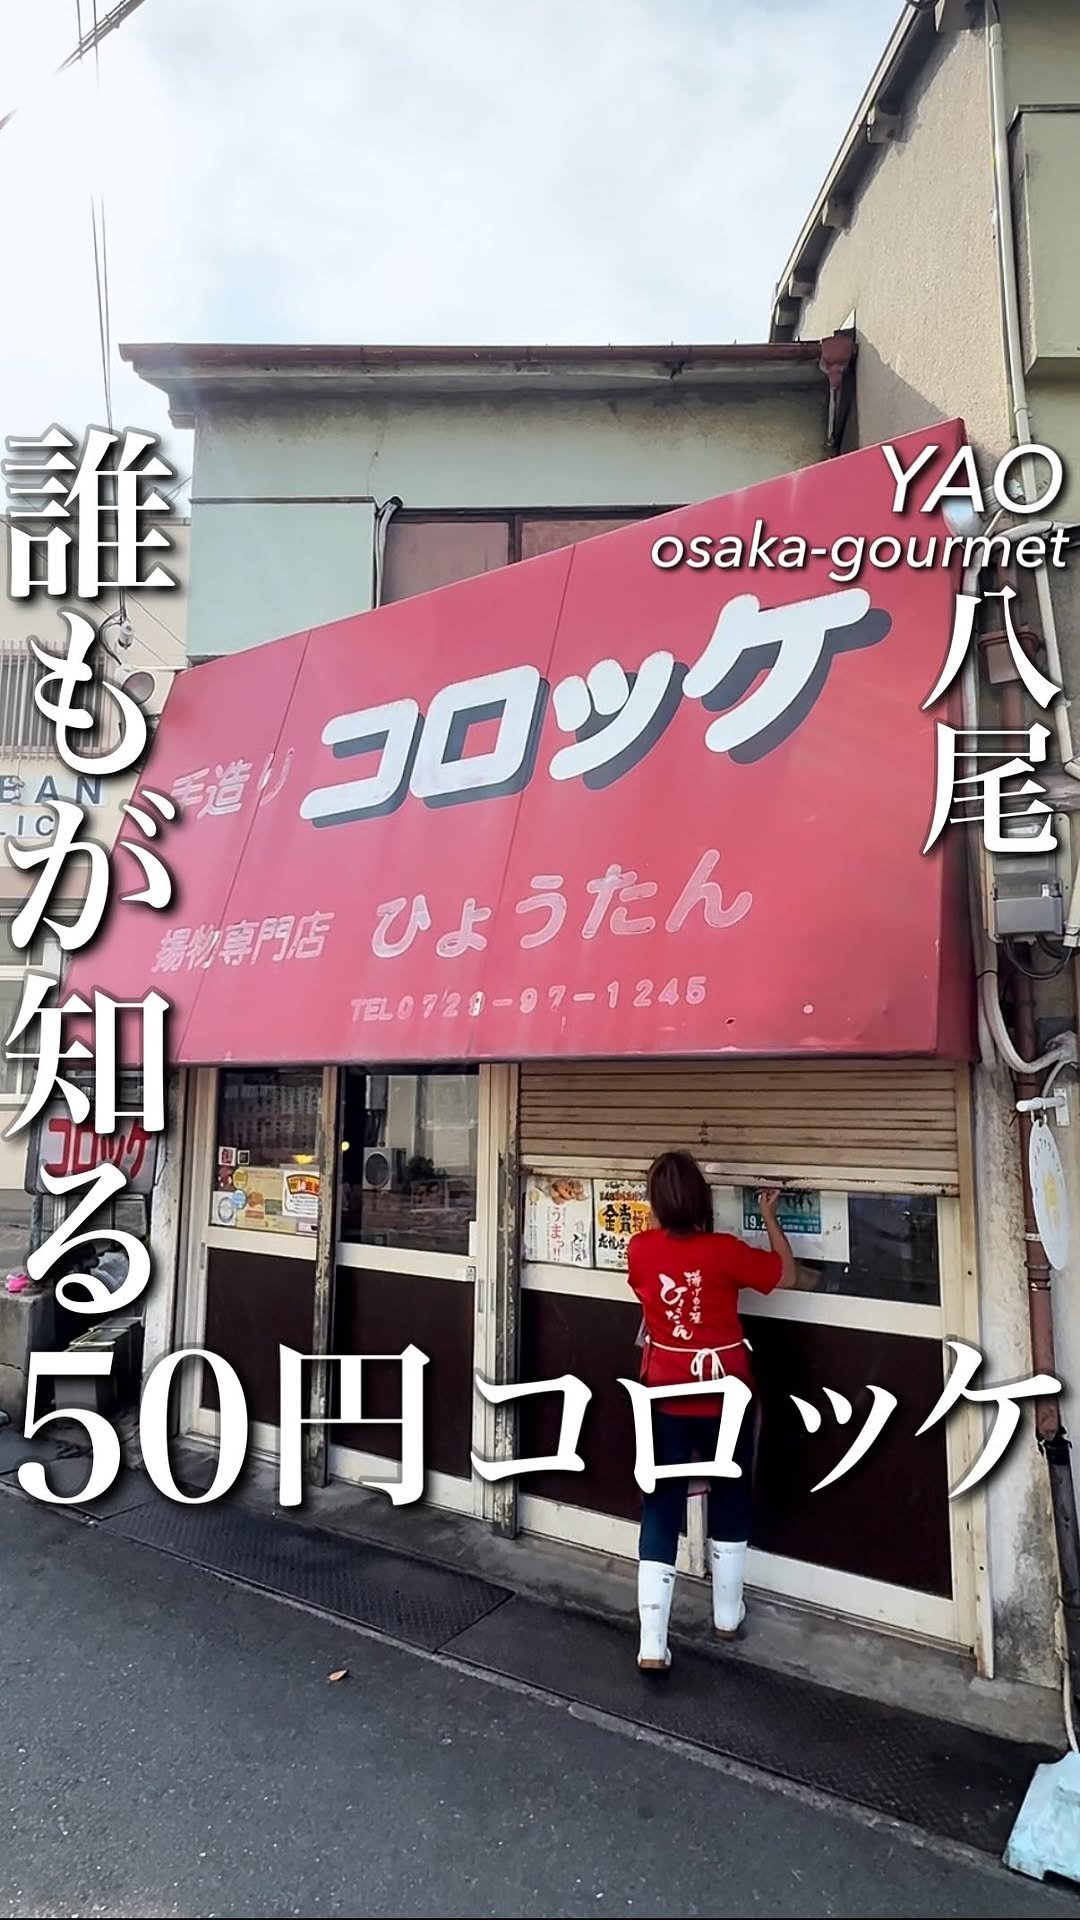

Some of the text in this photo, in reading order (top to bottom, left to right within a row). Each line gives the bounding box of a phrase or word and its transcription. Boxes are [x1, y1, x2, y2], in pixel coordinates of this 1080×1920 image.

[299, 587, 892, 829] コロッケ
[170, 747, 295, 820] 手造り
[151, 910, 335, 973] 揚物専門店
[370, 848, 753, 959] ひょうたん
